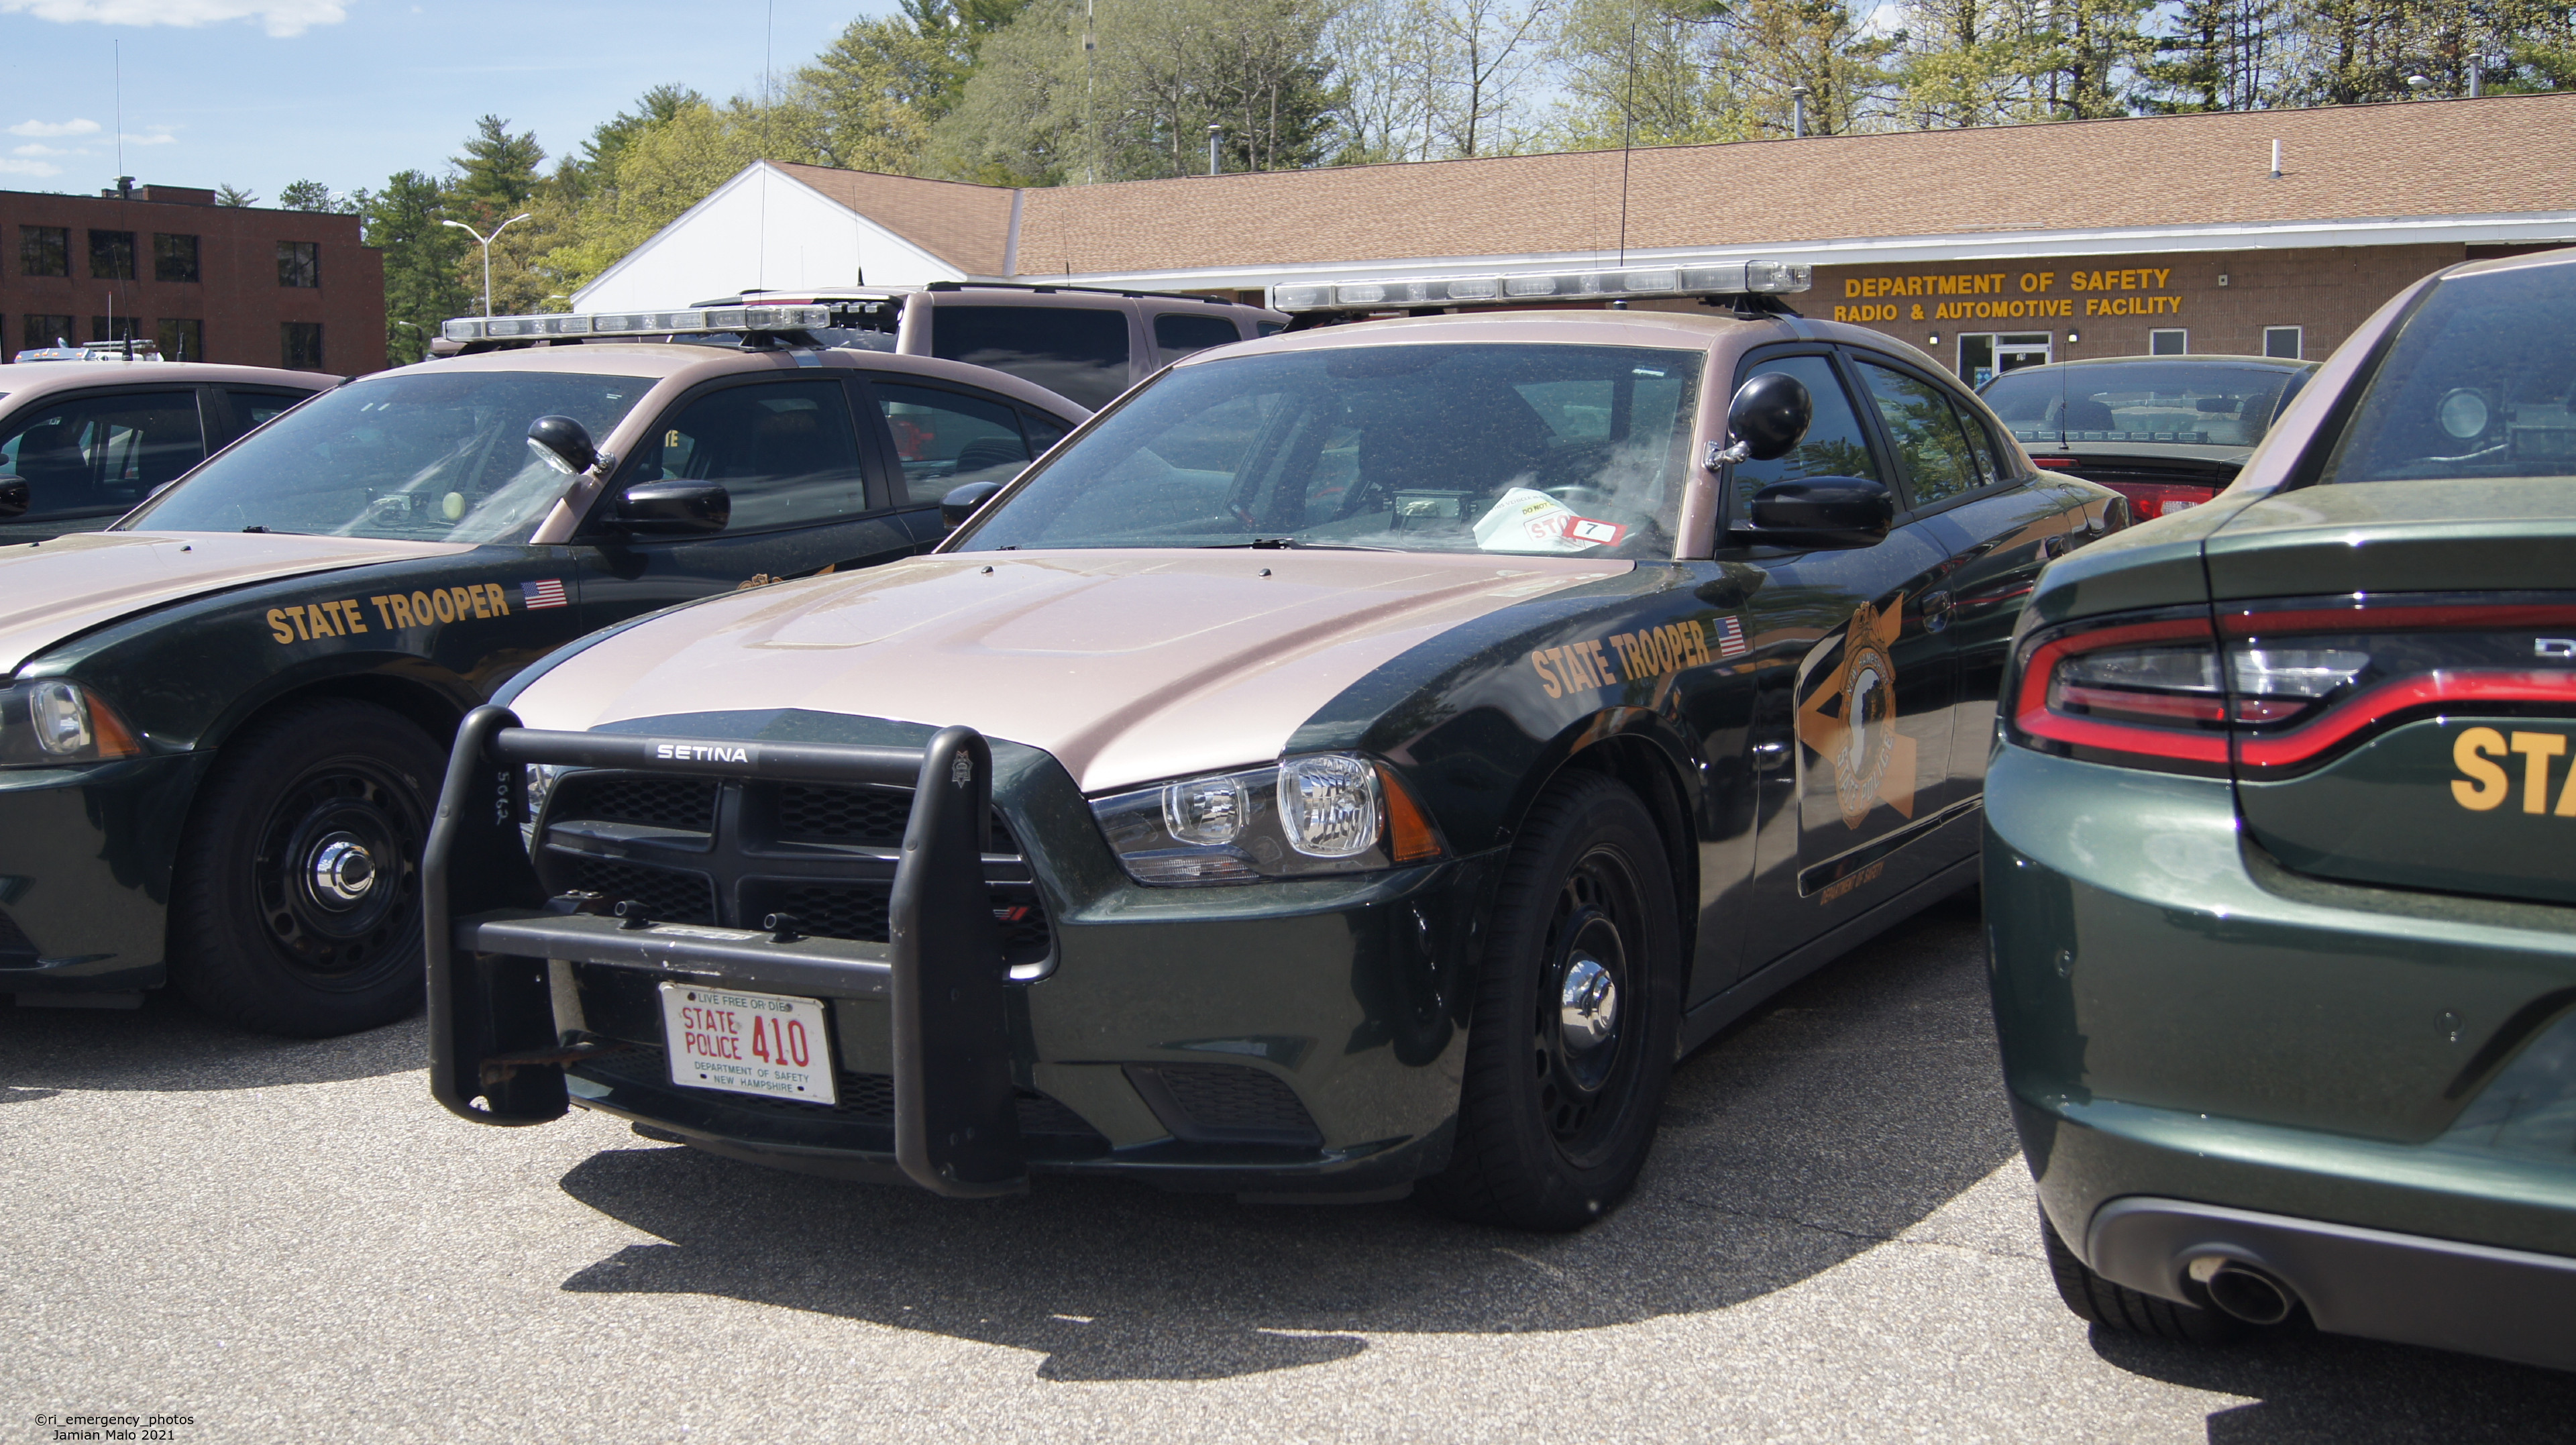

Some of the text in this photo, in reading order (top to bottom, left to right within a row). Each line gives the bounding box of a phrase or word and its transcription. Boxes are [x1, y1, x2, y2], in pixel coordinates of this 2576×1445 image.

[1845, 268, 2171, 298] DEPARTMENT OF SAFETY
[1834, 296, 2182, 322] RADIO & AUTOMOTIVE FACILITY
[1522, 507, 1533, 515] DO
[1534, 502, 1548, 511] NOT
[1531, 514, 1574, 540] STO
[1585, 523, 1599, 535] 7
[266, 583, 511, 645] STATE TROOPER
[1531, 620, 1711, 699] STATE TROOPER
[1846, 652, 1890, 697] NEW HAMPSHIRE
[657, 744, 749, 763] SETINA
[1836, 731, 1894, 812] STATE POLICE
[698, 994, 786, 1012] LIVE FREE OR DIE
[683, 1007, 738, 1034] STATE
[685, 1032, 742, 1060] POLICE
[753, 1015, 810, 1067] 410
[694, 1061, 810, 1083] DEPARTMENT OF SAFETY
[714, 1075, 793, 1093] NEW HAMPSHIRE
